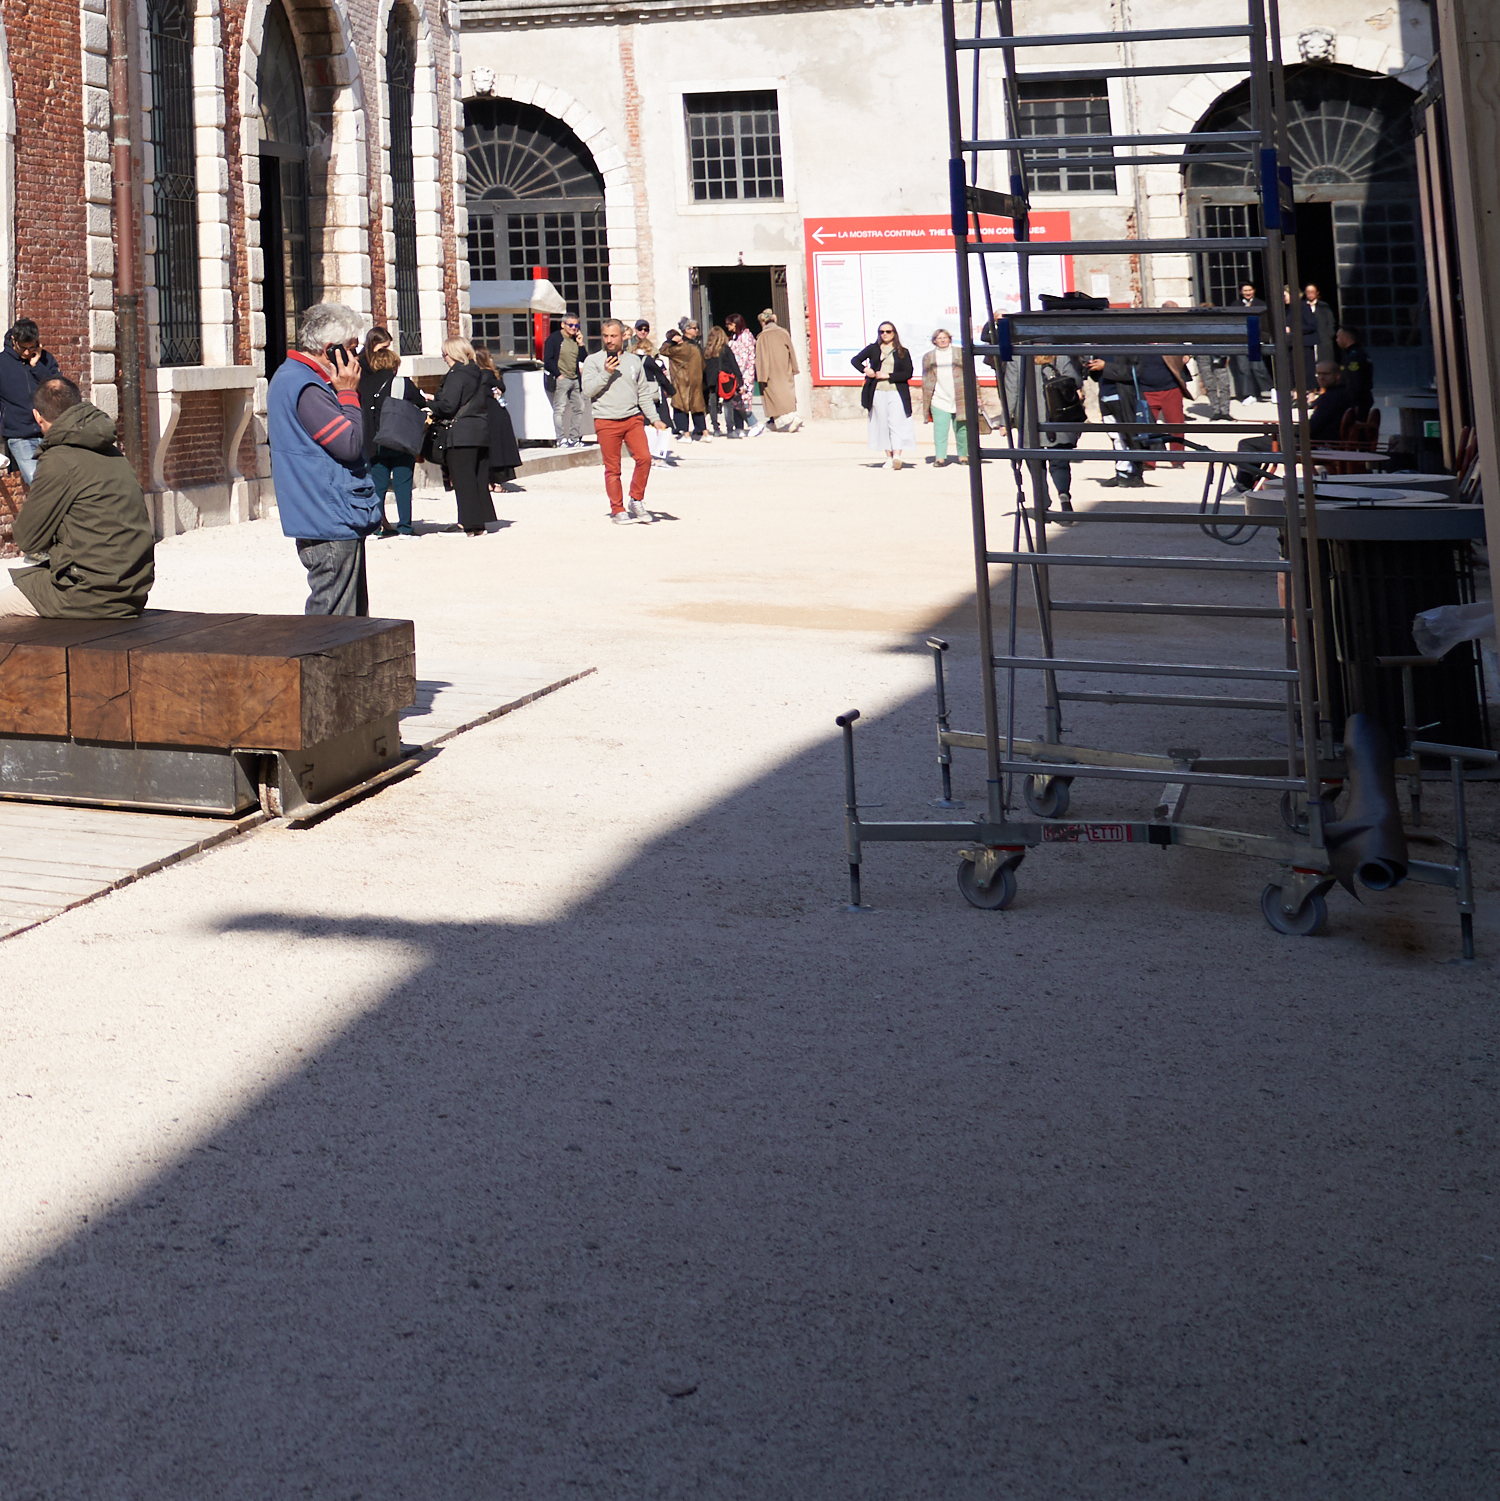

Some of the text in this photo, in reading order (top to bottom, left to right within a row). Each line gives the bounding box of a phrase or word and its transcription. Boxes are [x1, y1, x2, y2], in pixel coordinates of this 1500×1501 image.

[850, 230, 883, 238] MOSTRA
[884, 229, 925, 237] CONTINUA
[929, 228, 946, 236] THE
